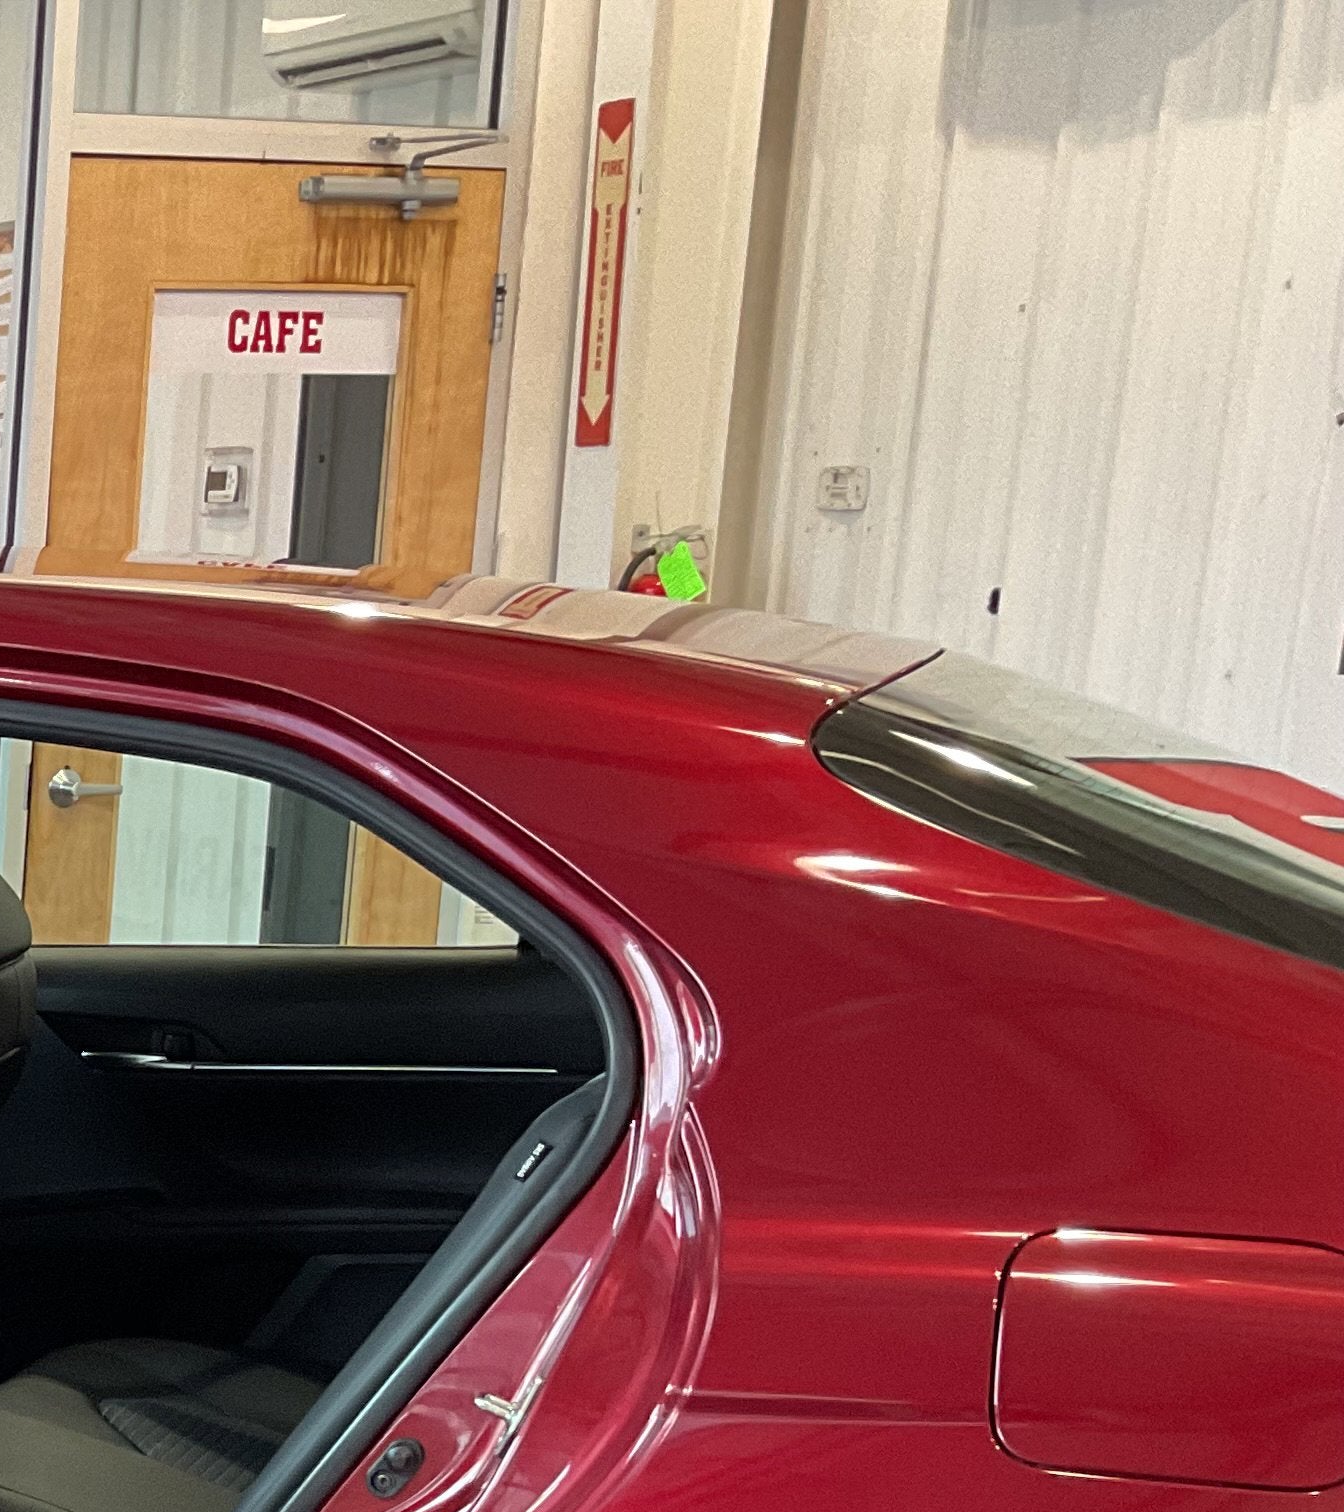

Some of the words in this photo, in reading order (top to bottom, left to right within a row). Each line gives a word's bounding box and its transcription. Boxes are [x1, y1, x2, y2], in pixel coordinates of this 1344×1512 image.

[600, 159, 625, 177] FIRE
[594, 203, 613, 371] EXTINGUISHER
[227, 309, 324, 354] CAFE
